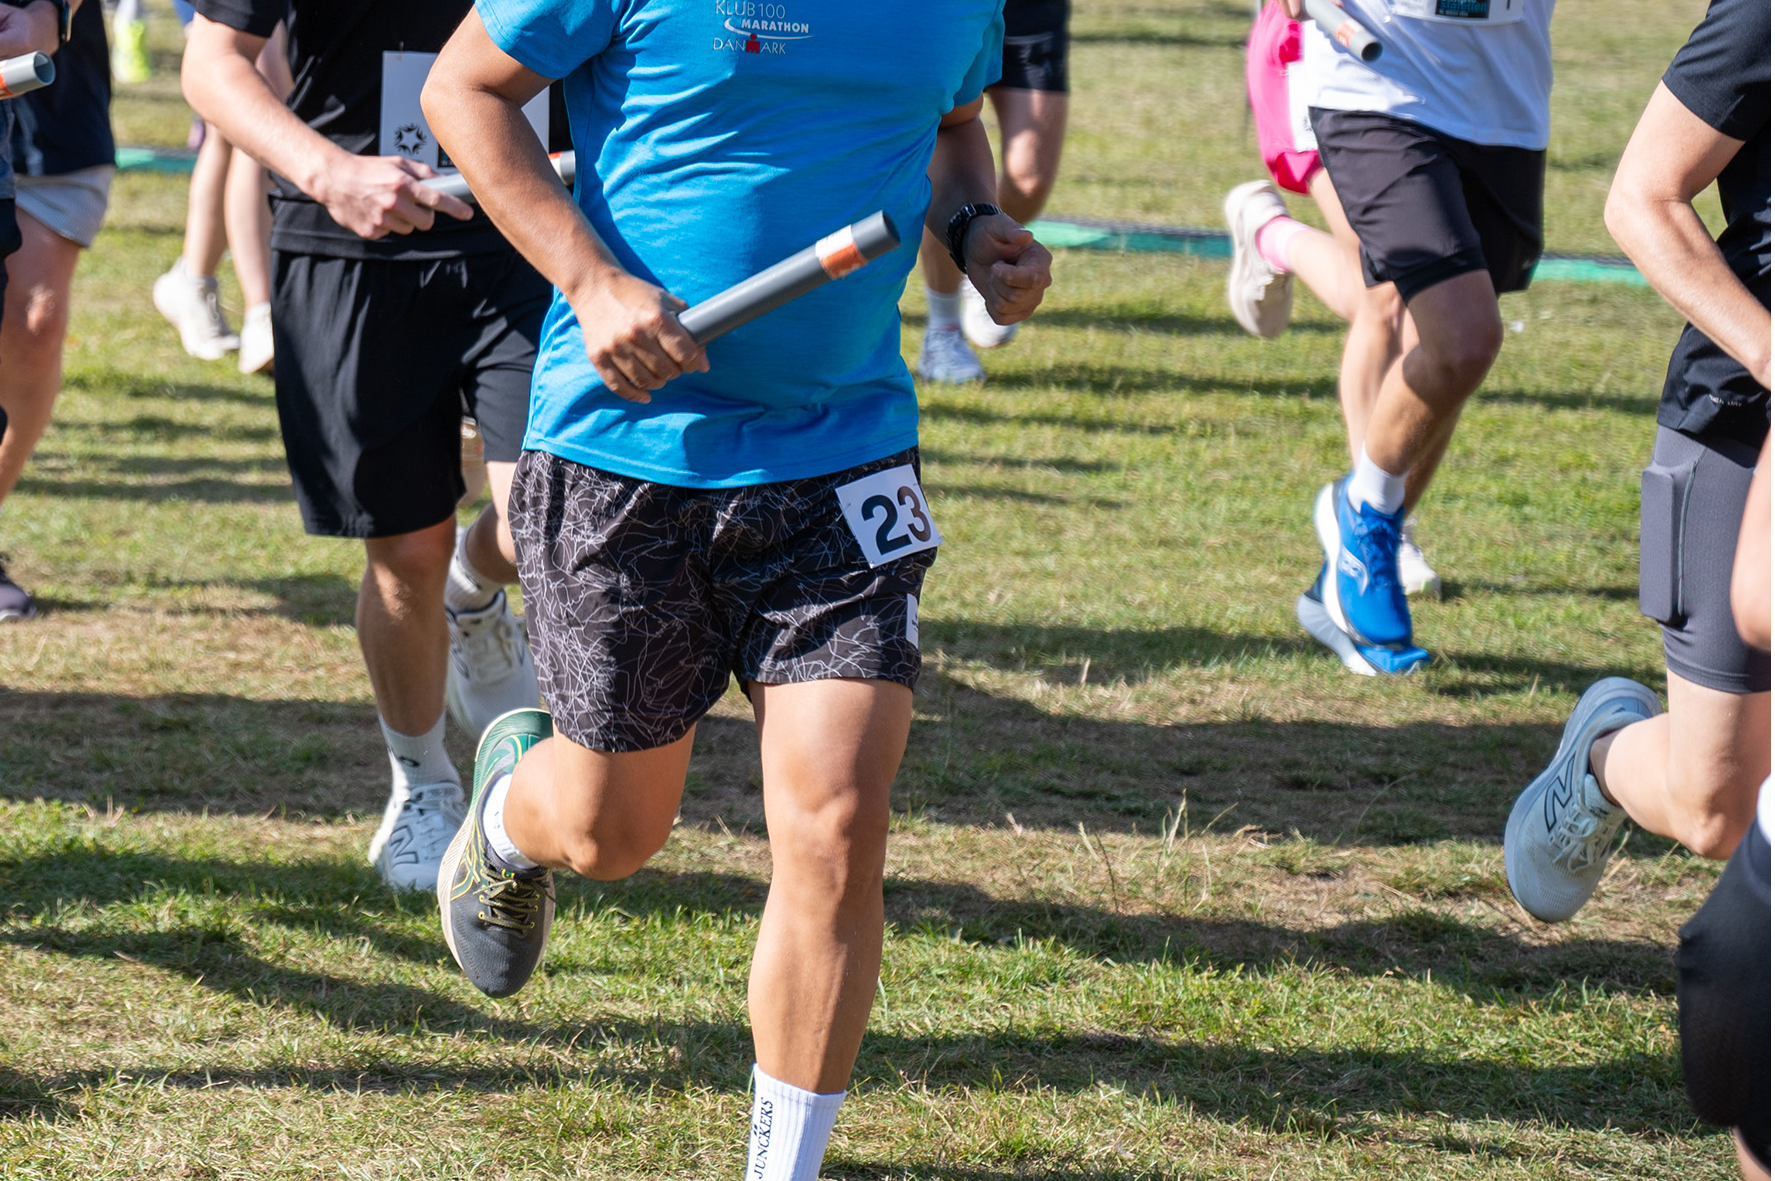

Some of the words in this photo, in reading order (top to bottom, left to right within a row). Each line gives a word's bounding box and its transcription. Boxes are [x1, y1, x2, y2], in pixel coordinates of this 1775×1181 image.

[713, 35, 786, 55] DANMARK
[741, 18, 809, 33] MARATHON
[861, 485, 932, 556] 23
[753, 1097, 773, 1179] JUNCKERS
